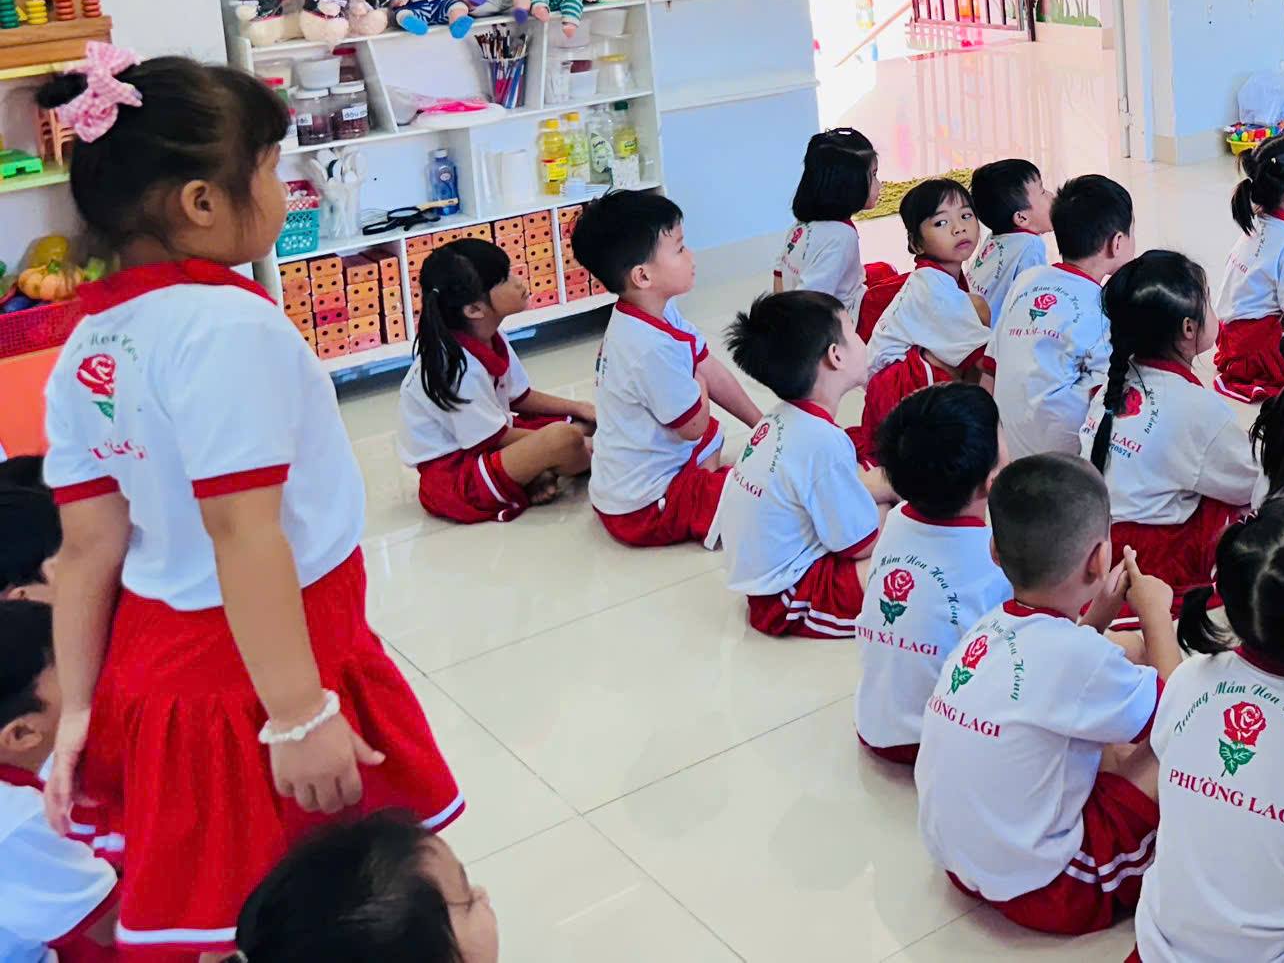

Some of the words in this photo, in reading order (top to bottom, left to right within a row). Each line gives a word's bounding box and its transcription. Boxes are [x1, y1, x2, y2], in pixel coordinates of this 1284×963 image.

[1111, 432, 1142, 454] LAGI
[739, 477, 764, 499] LAGI
[905, 554, 928, 569] Non
[929, 566, 949, 590] Hoa
[856, 626, 874, 643] THỊ
[877, 631, 894, 646] XÃ
[898, 637, 939, 656] LAGI
[1250, 683, 1281, 705] Non
[929, 695, 957, 722] ƯỜNG
[958, 712, 1001, 738] LAGI
[1168, 768, 1244, 808] PHƯỜNG
